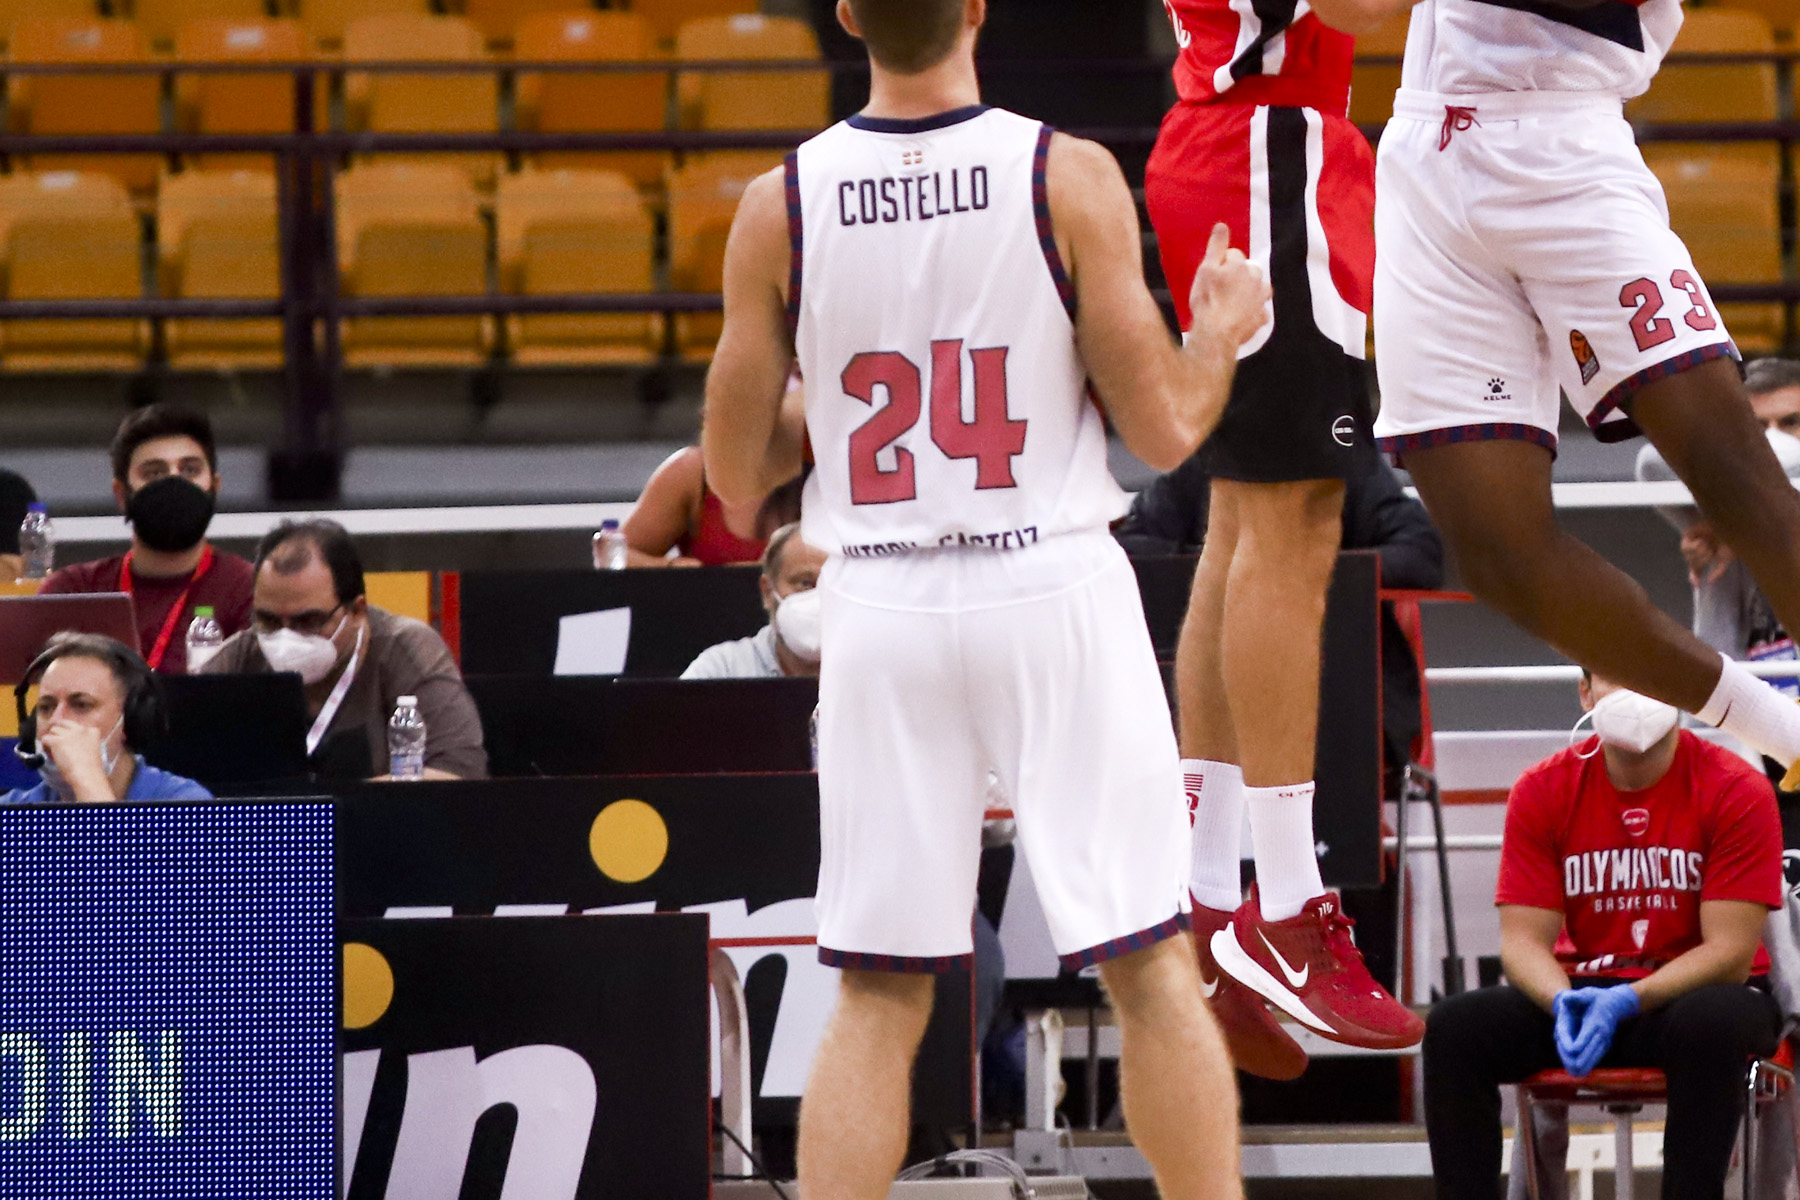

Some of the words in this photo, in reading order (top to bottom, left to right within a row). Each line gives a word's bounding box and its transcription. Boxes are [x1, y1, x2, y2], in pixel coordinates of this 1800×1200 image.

[838, 164, 989, 227] COSTELLO
[1618, 268, 1717, 353] 23
[840, 337, 1028, 506] 24
[1483, 394, 1512, 402] KELME
[1565, 846, 1703, 896] OLYMCOS
